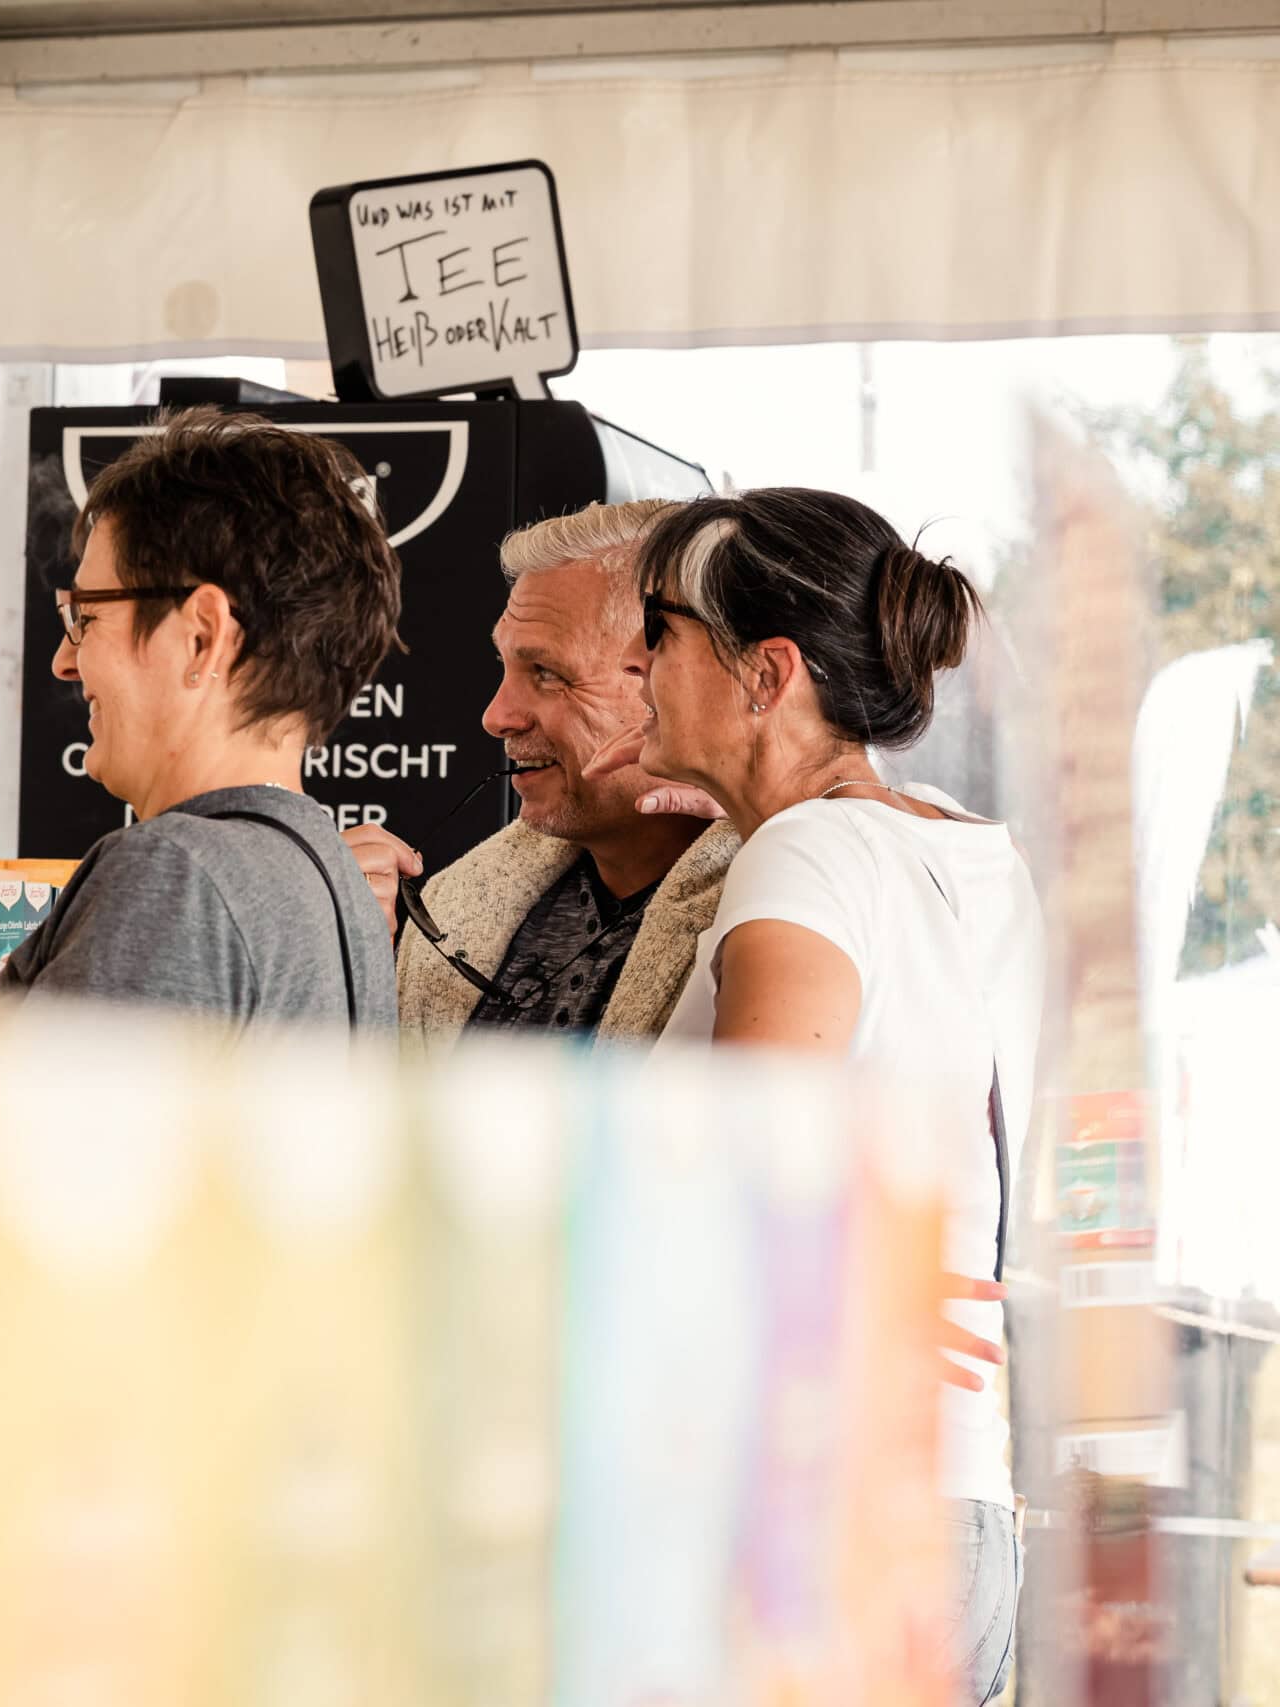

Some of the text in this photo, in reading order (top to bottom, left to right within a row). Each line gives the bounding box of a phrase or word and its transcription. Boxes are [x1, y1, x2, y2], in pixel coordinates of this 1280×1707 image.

[395, 200, 435, 221] WAS
[444, 193, 474, 216] IST
[375, 229, 529, 304] TEE
[445, 317, 491, 345] ODER
[489, 297, 559, 353] KALT
[350, 683, 404, 718] EN
[304, 743, 457, 779] RISCHT
